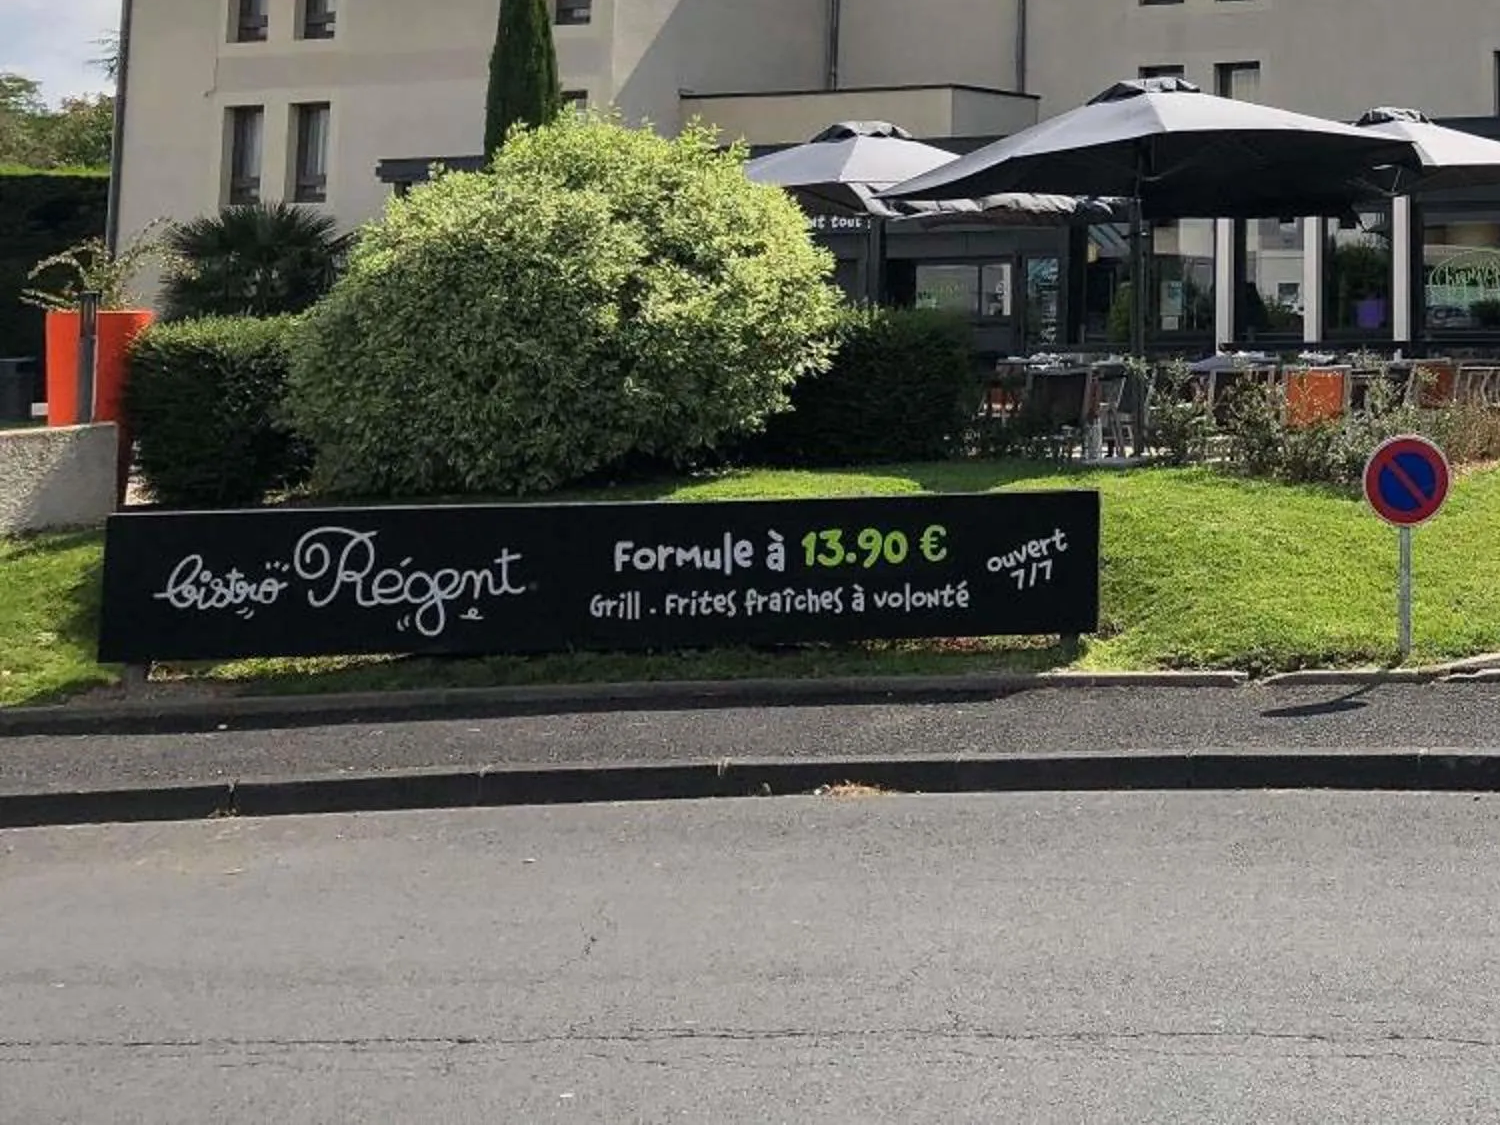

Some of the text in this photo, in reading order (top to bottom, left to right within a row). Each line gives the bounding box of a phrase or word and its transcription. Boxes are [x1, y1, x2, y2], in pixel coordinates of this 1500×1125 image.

[614, 525, 947, 575] Formule à 13.90 €
[987, 528, 1067, 573] ouvert
[153, 527, 526, 636] bistro Régent
[1010, 560, 1053, 590] 7/7
[590, 581, 969, 620] Grill Frites fraîches à volonté
